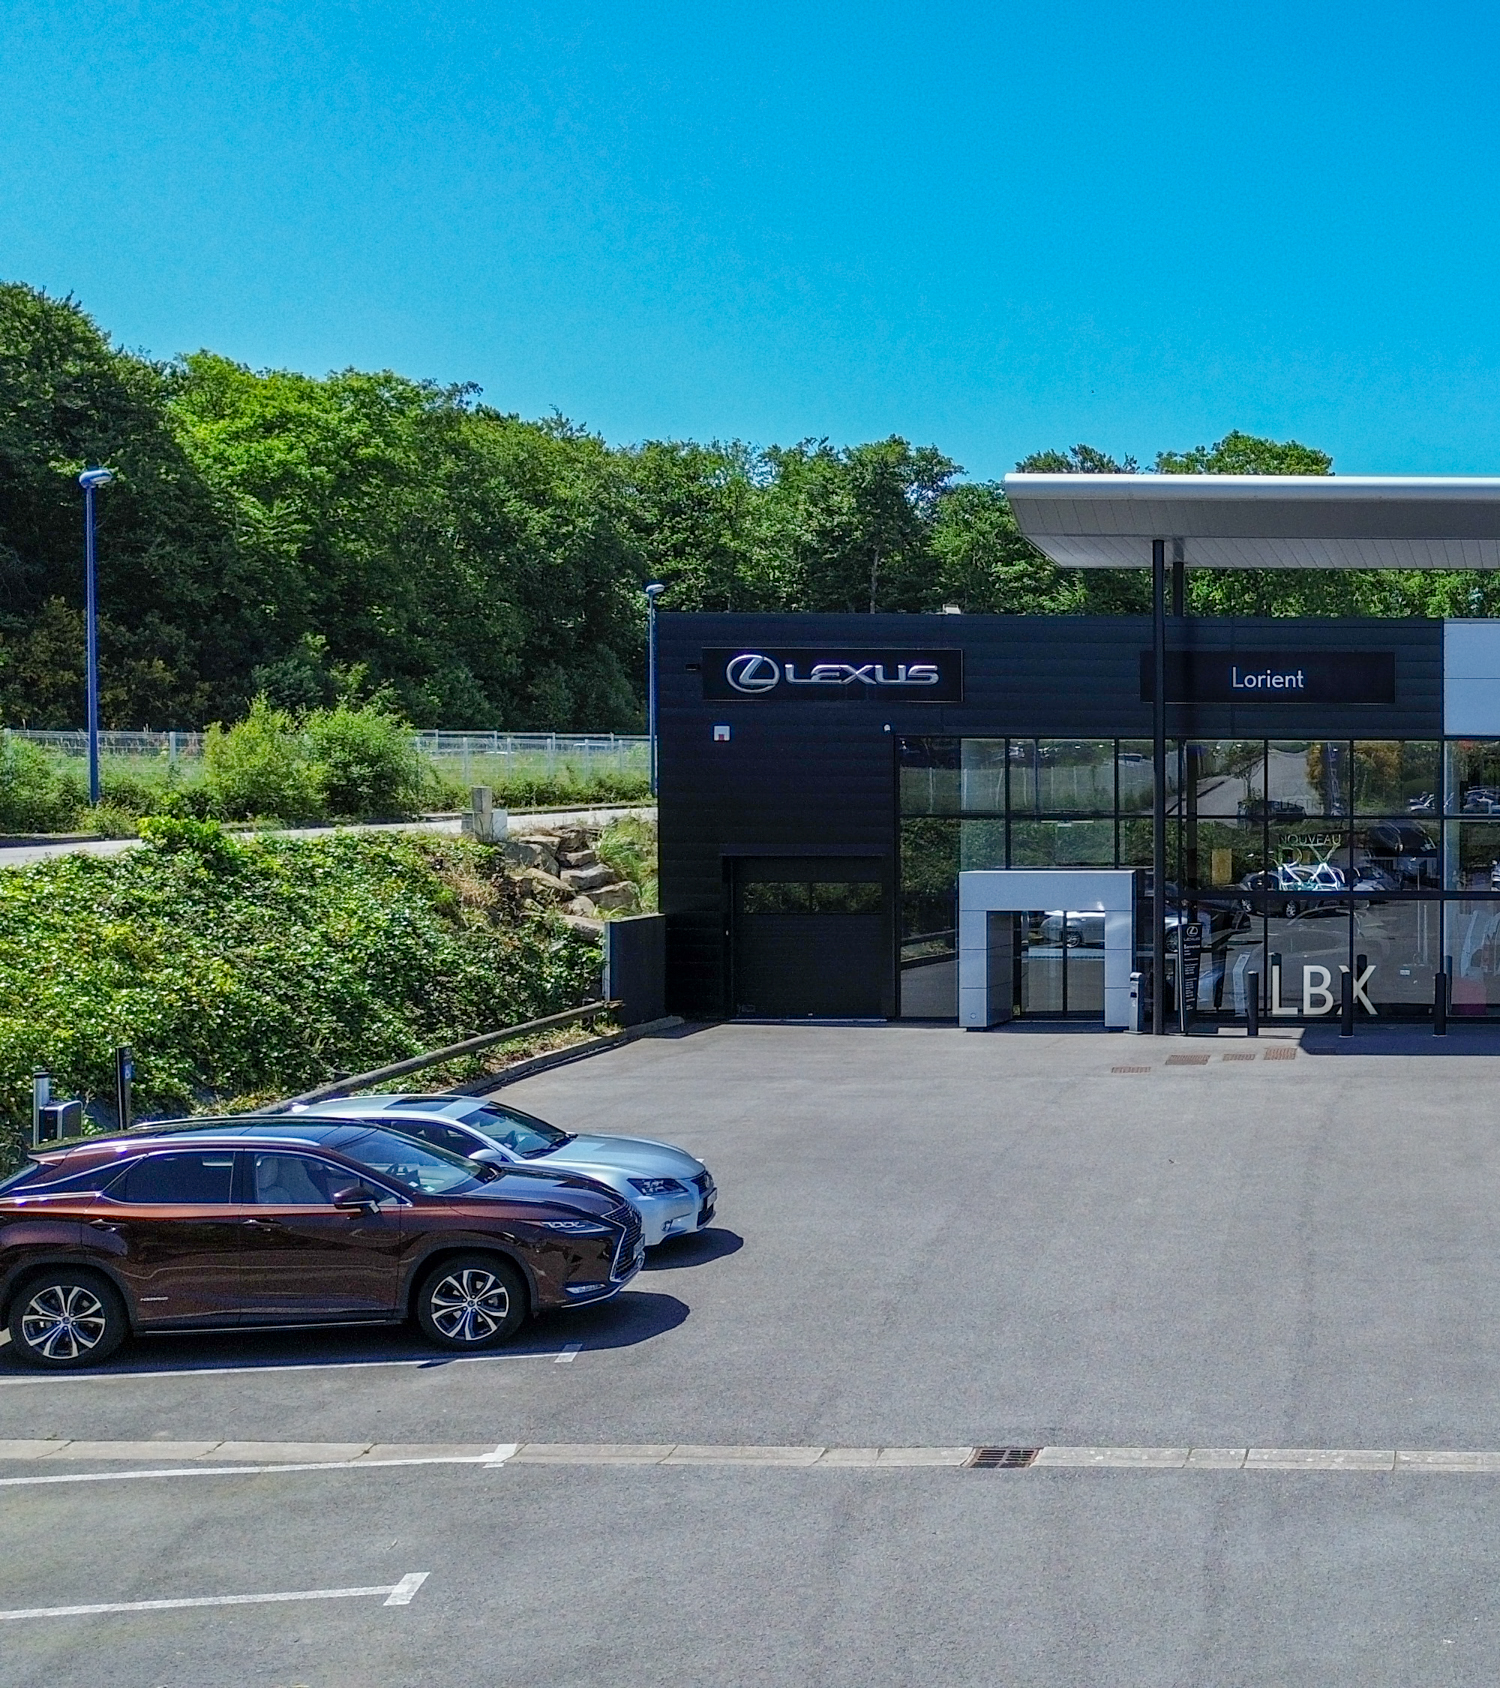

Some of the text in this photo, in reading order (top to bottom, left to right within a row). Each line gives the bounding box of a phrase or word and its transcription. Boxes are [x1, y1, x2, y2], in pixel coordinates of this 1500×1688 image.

[784, 663, 940, 686] LEXUS
[1232, 666, 1305, 688] Lorient
[1279, 833, 1342, 845] NOUVEAU
[1271, 964, 1379, 1016] LBX
